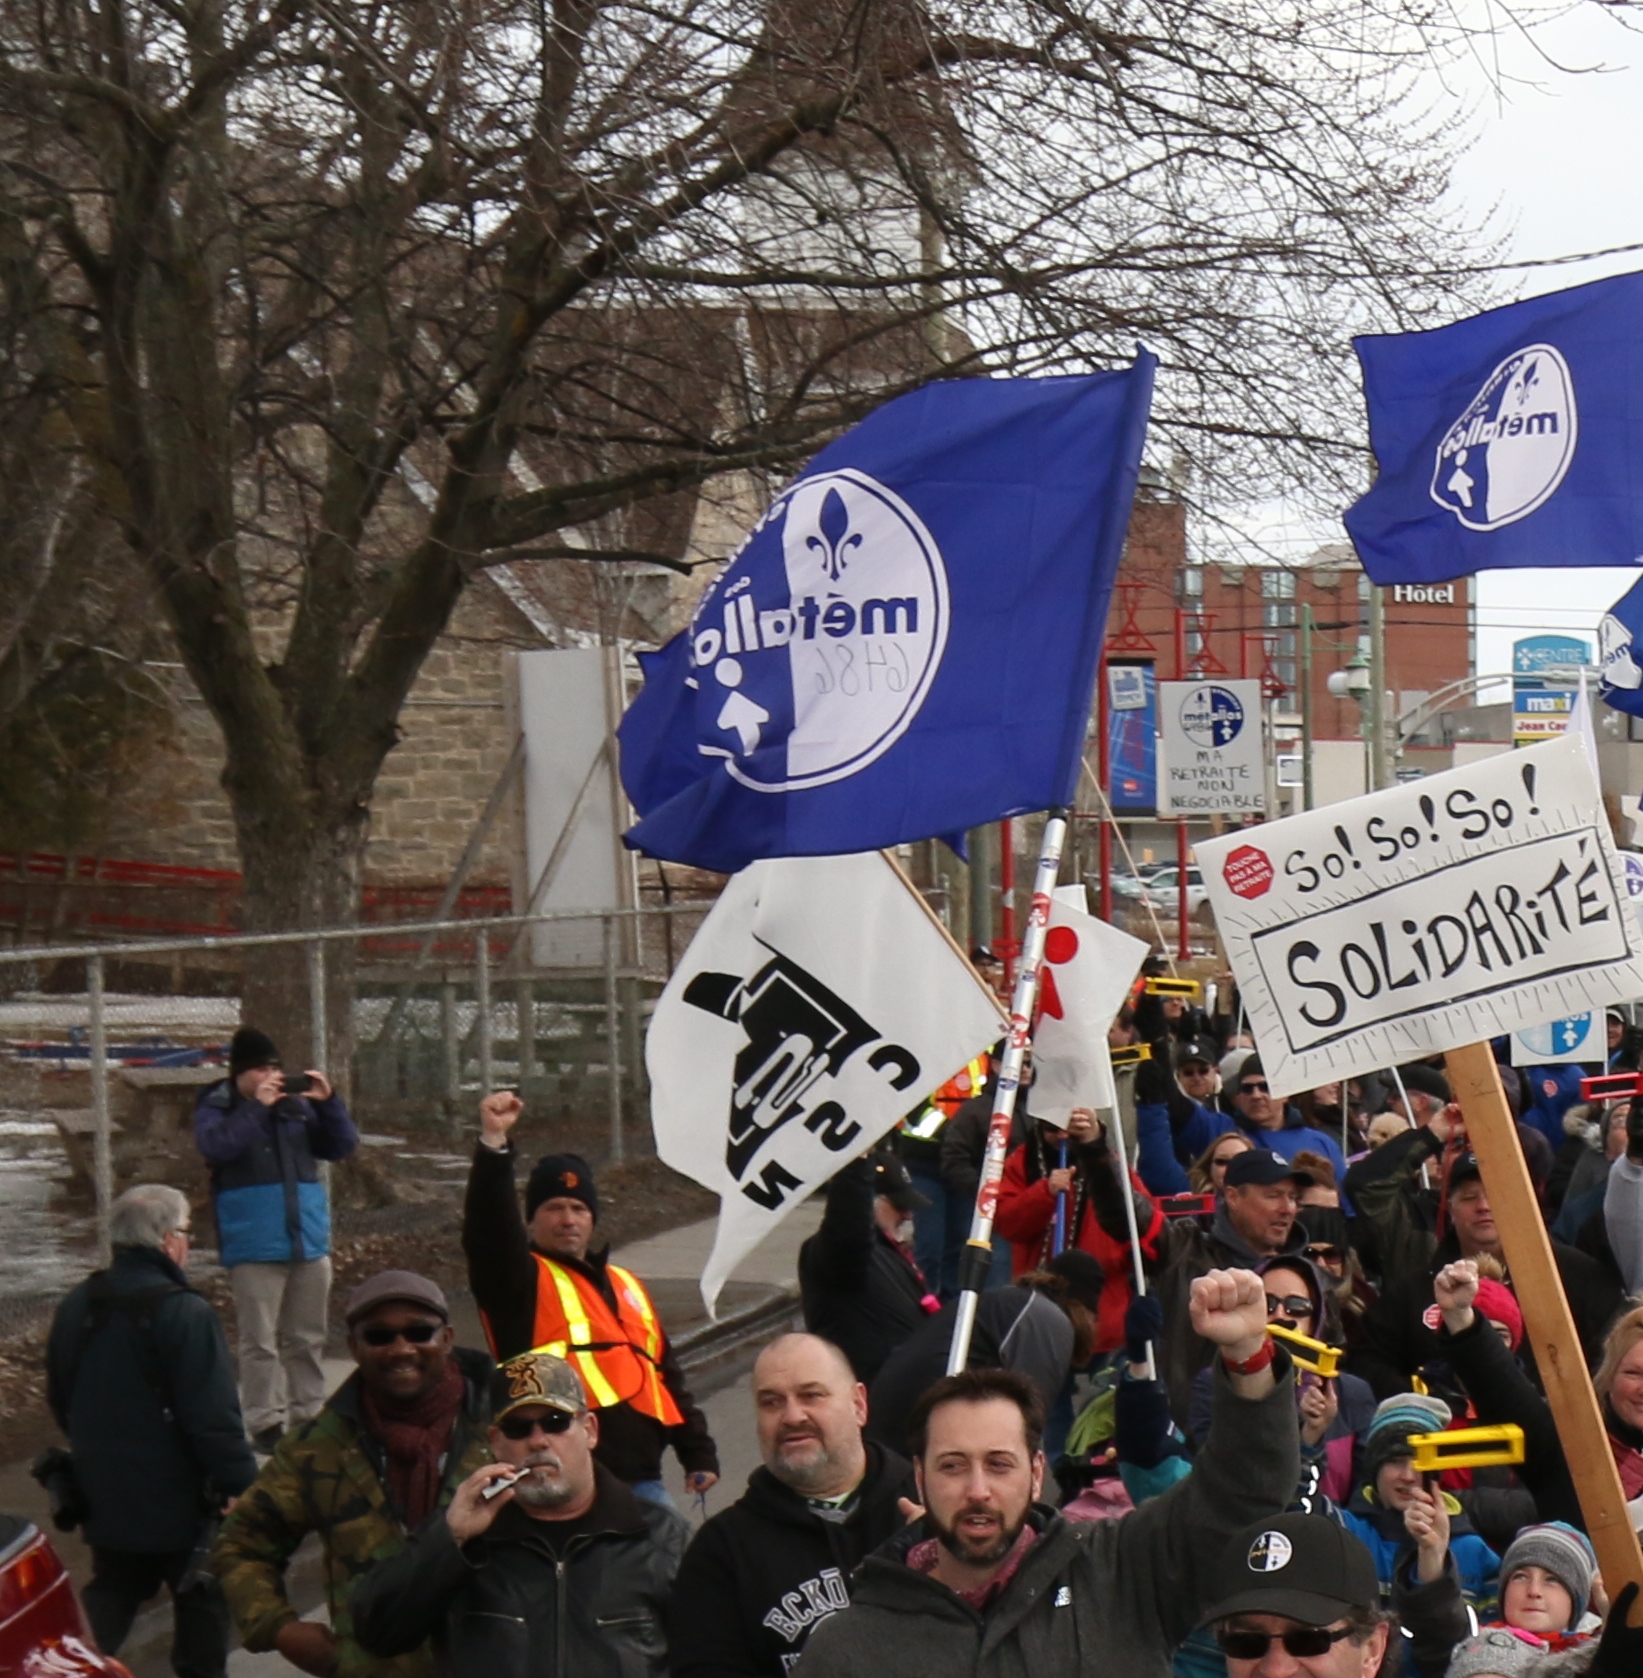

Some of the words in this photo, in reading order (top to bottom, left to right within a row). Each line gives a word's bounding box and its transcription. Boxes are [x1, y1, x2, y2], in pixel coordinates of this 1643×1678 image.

[1394, 584, 1454, 604] Hôtel
[1527, 693, 1572, 712] maxi
[1170, 764, 1250, 780] RETRAITE
[1198, 779, 1235, 792] NON
